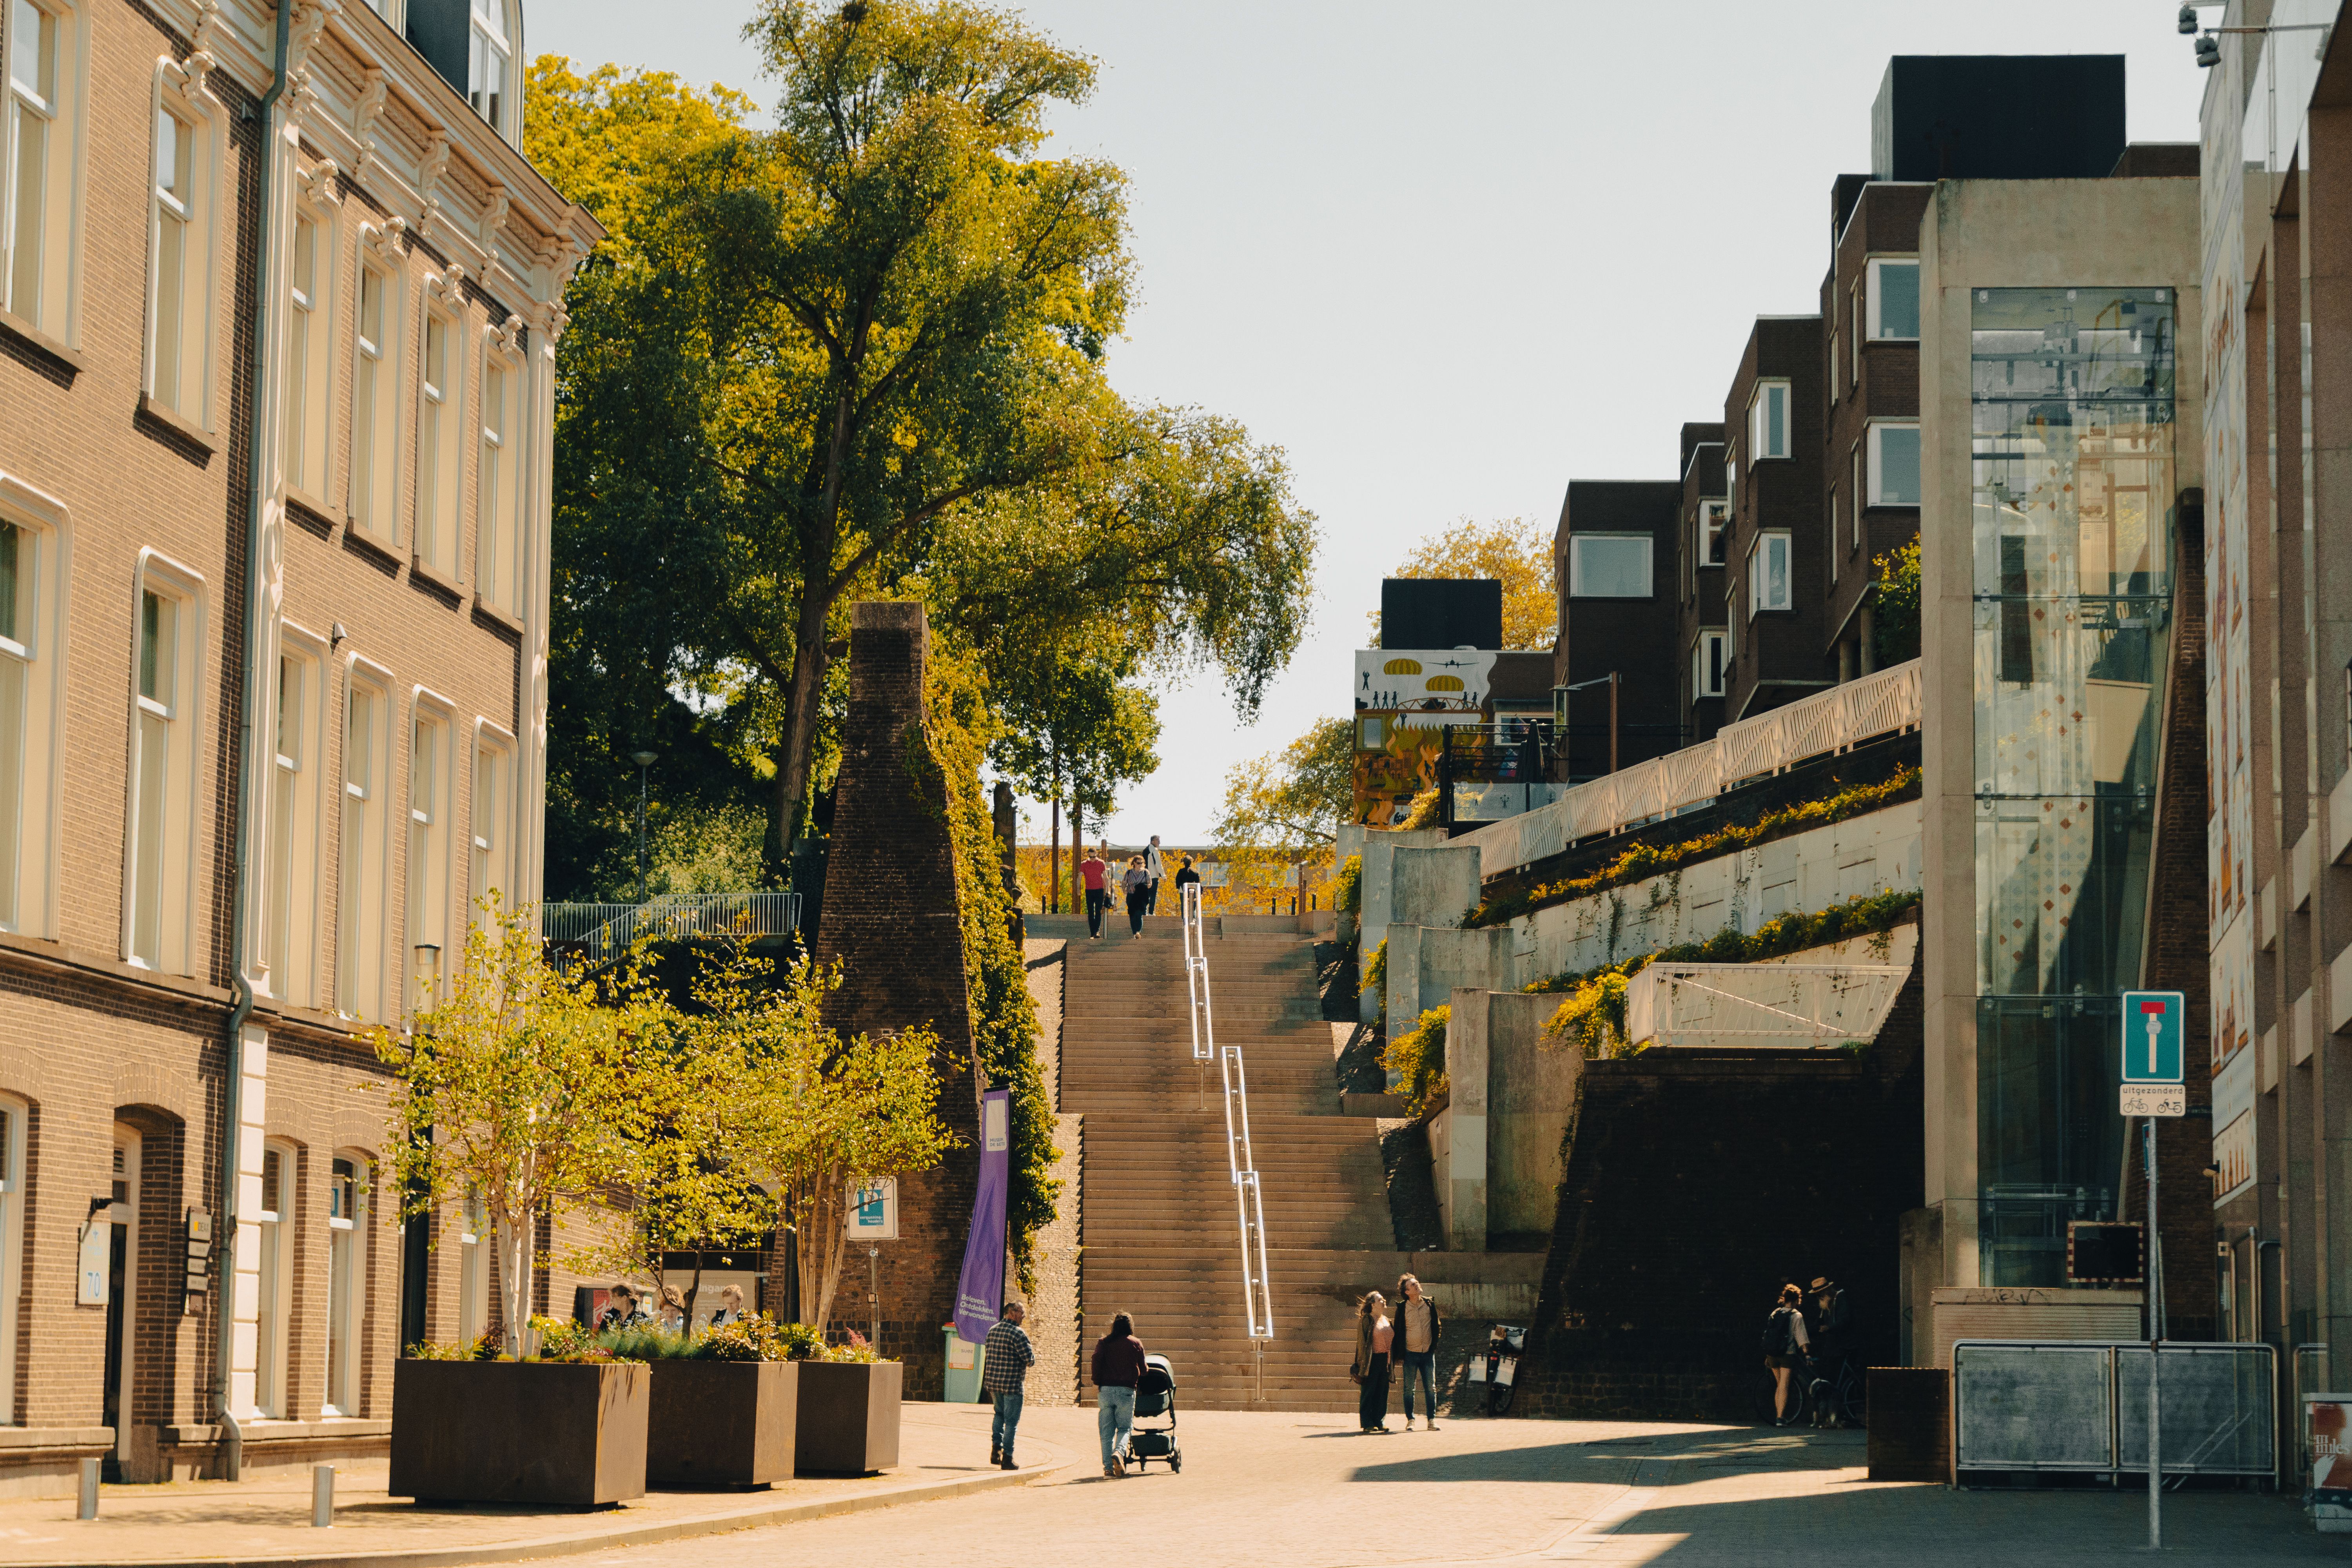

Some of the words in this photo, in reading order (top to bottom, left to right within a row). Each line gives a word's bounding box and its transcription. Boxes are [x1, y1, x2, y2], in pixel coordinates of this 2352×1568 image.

[2123, 1087, 2183, 1095] uitgezonderd
[87, 1271, 101, 1297] 70
[961, 1294, 986, 1305] Beleven.
[960, 1301, 995, 1314] Ontdekken.
[958, 1308, 998, 1322] Verwonderen.
